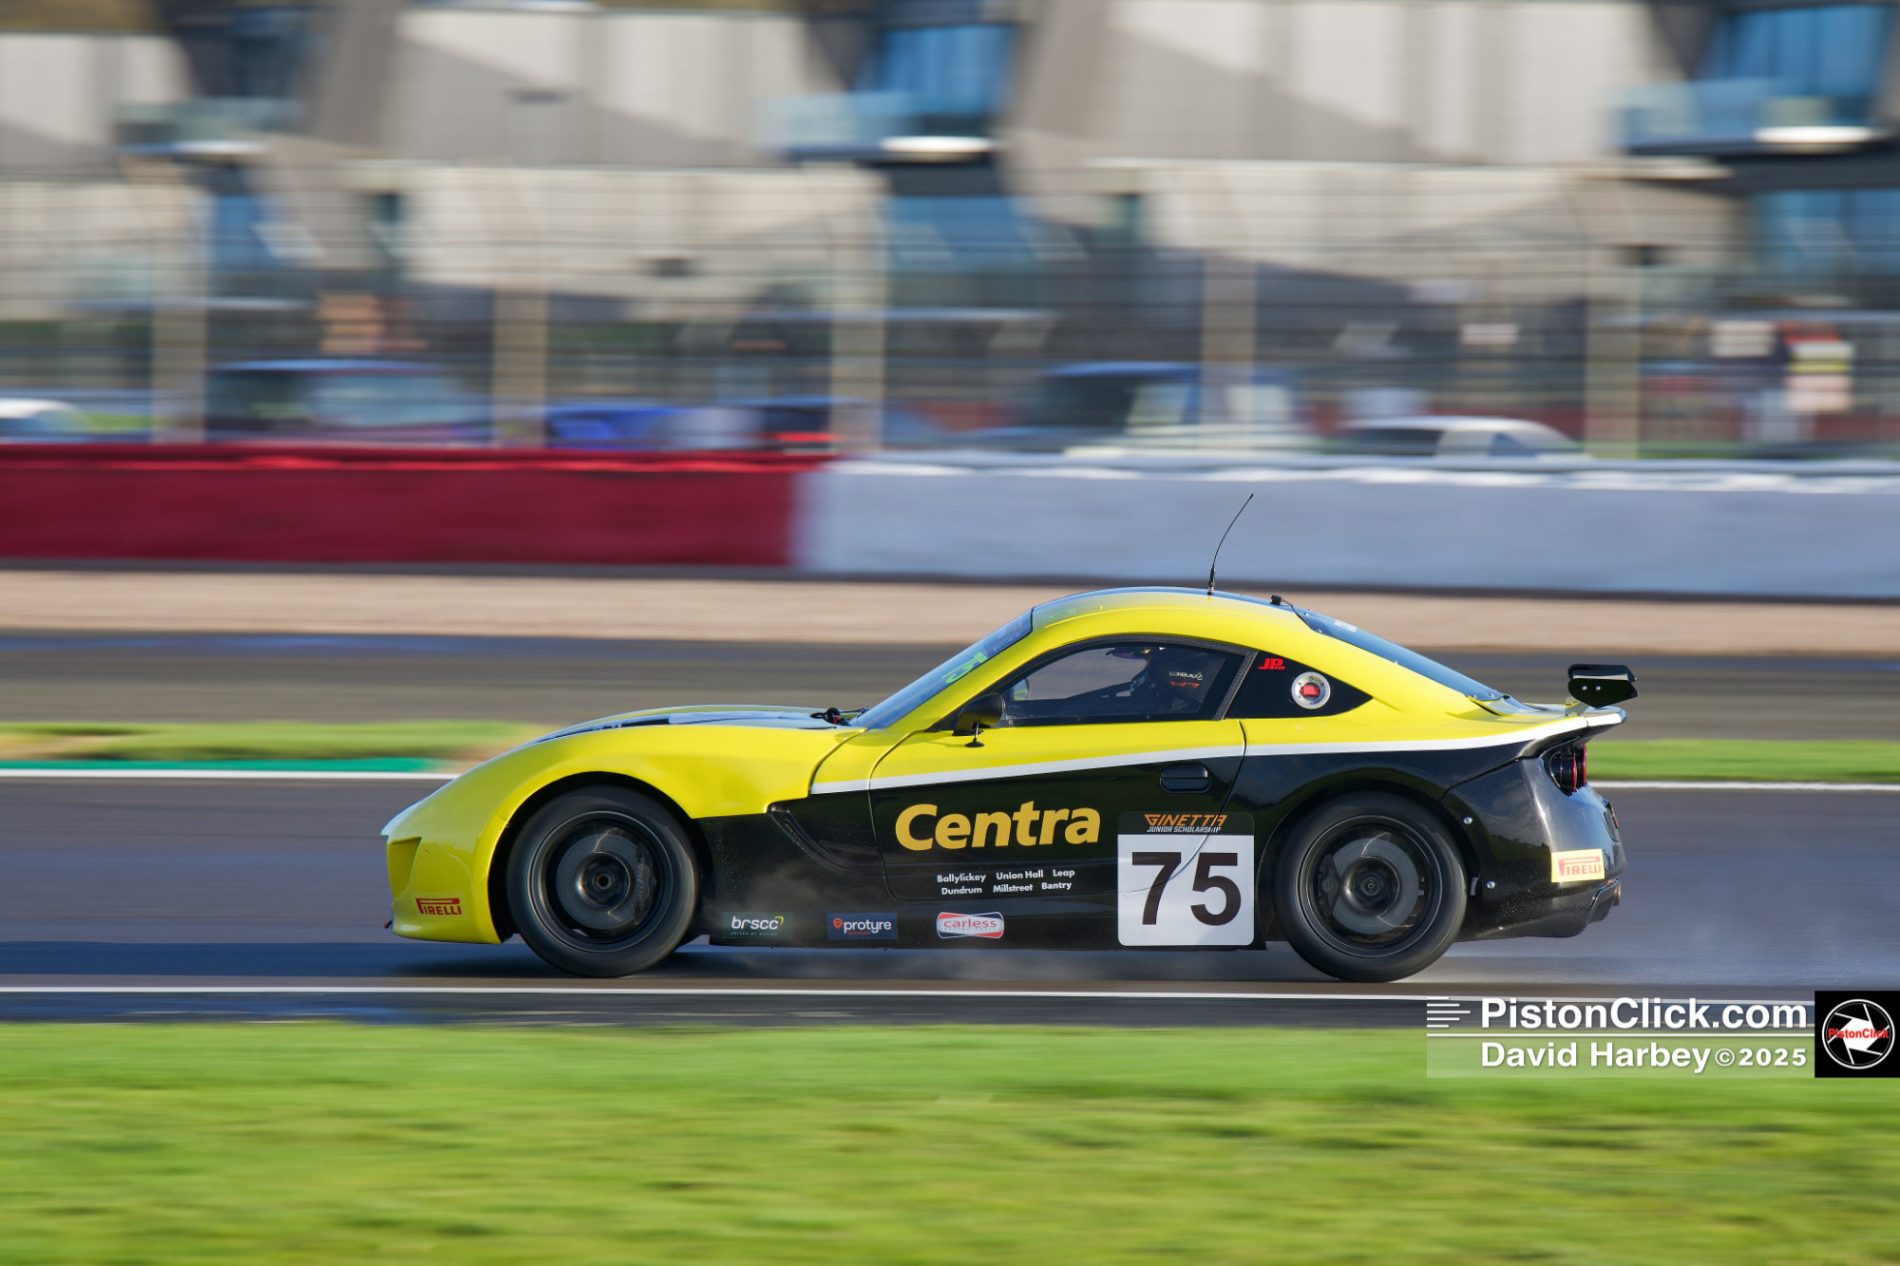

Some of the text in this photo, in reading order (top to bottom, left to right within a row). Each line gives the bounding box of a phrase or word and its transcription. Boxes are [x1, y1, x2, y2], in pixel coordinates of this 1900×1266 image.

[895, 800, 1101, 851] Centra
[1144, 814, 1228, 826] GINETTA
[1559, 856, 1601, 876] PIRELLI
[936, 869, 1076, 884] Ballylickey Union Hall Leap
[941, 881, 1072, 896] Dundrum Millstreet Bantry
[1132, 851, 1242, 926] 75
[415, 897, 462, 916] PIRELLI
[731, 916, 779, 930] brscc
[843, 918, 892, 934] protyre
[943, 918, 997, 929] carless
